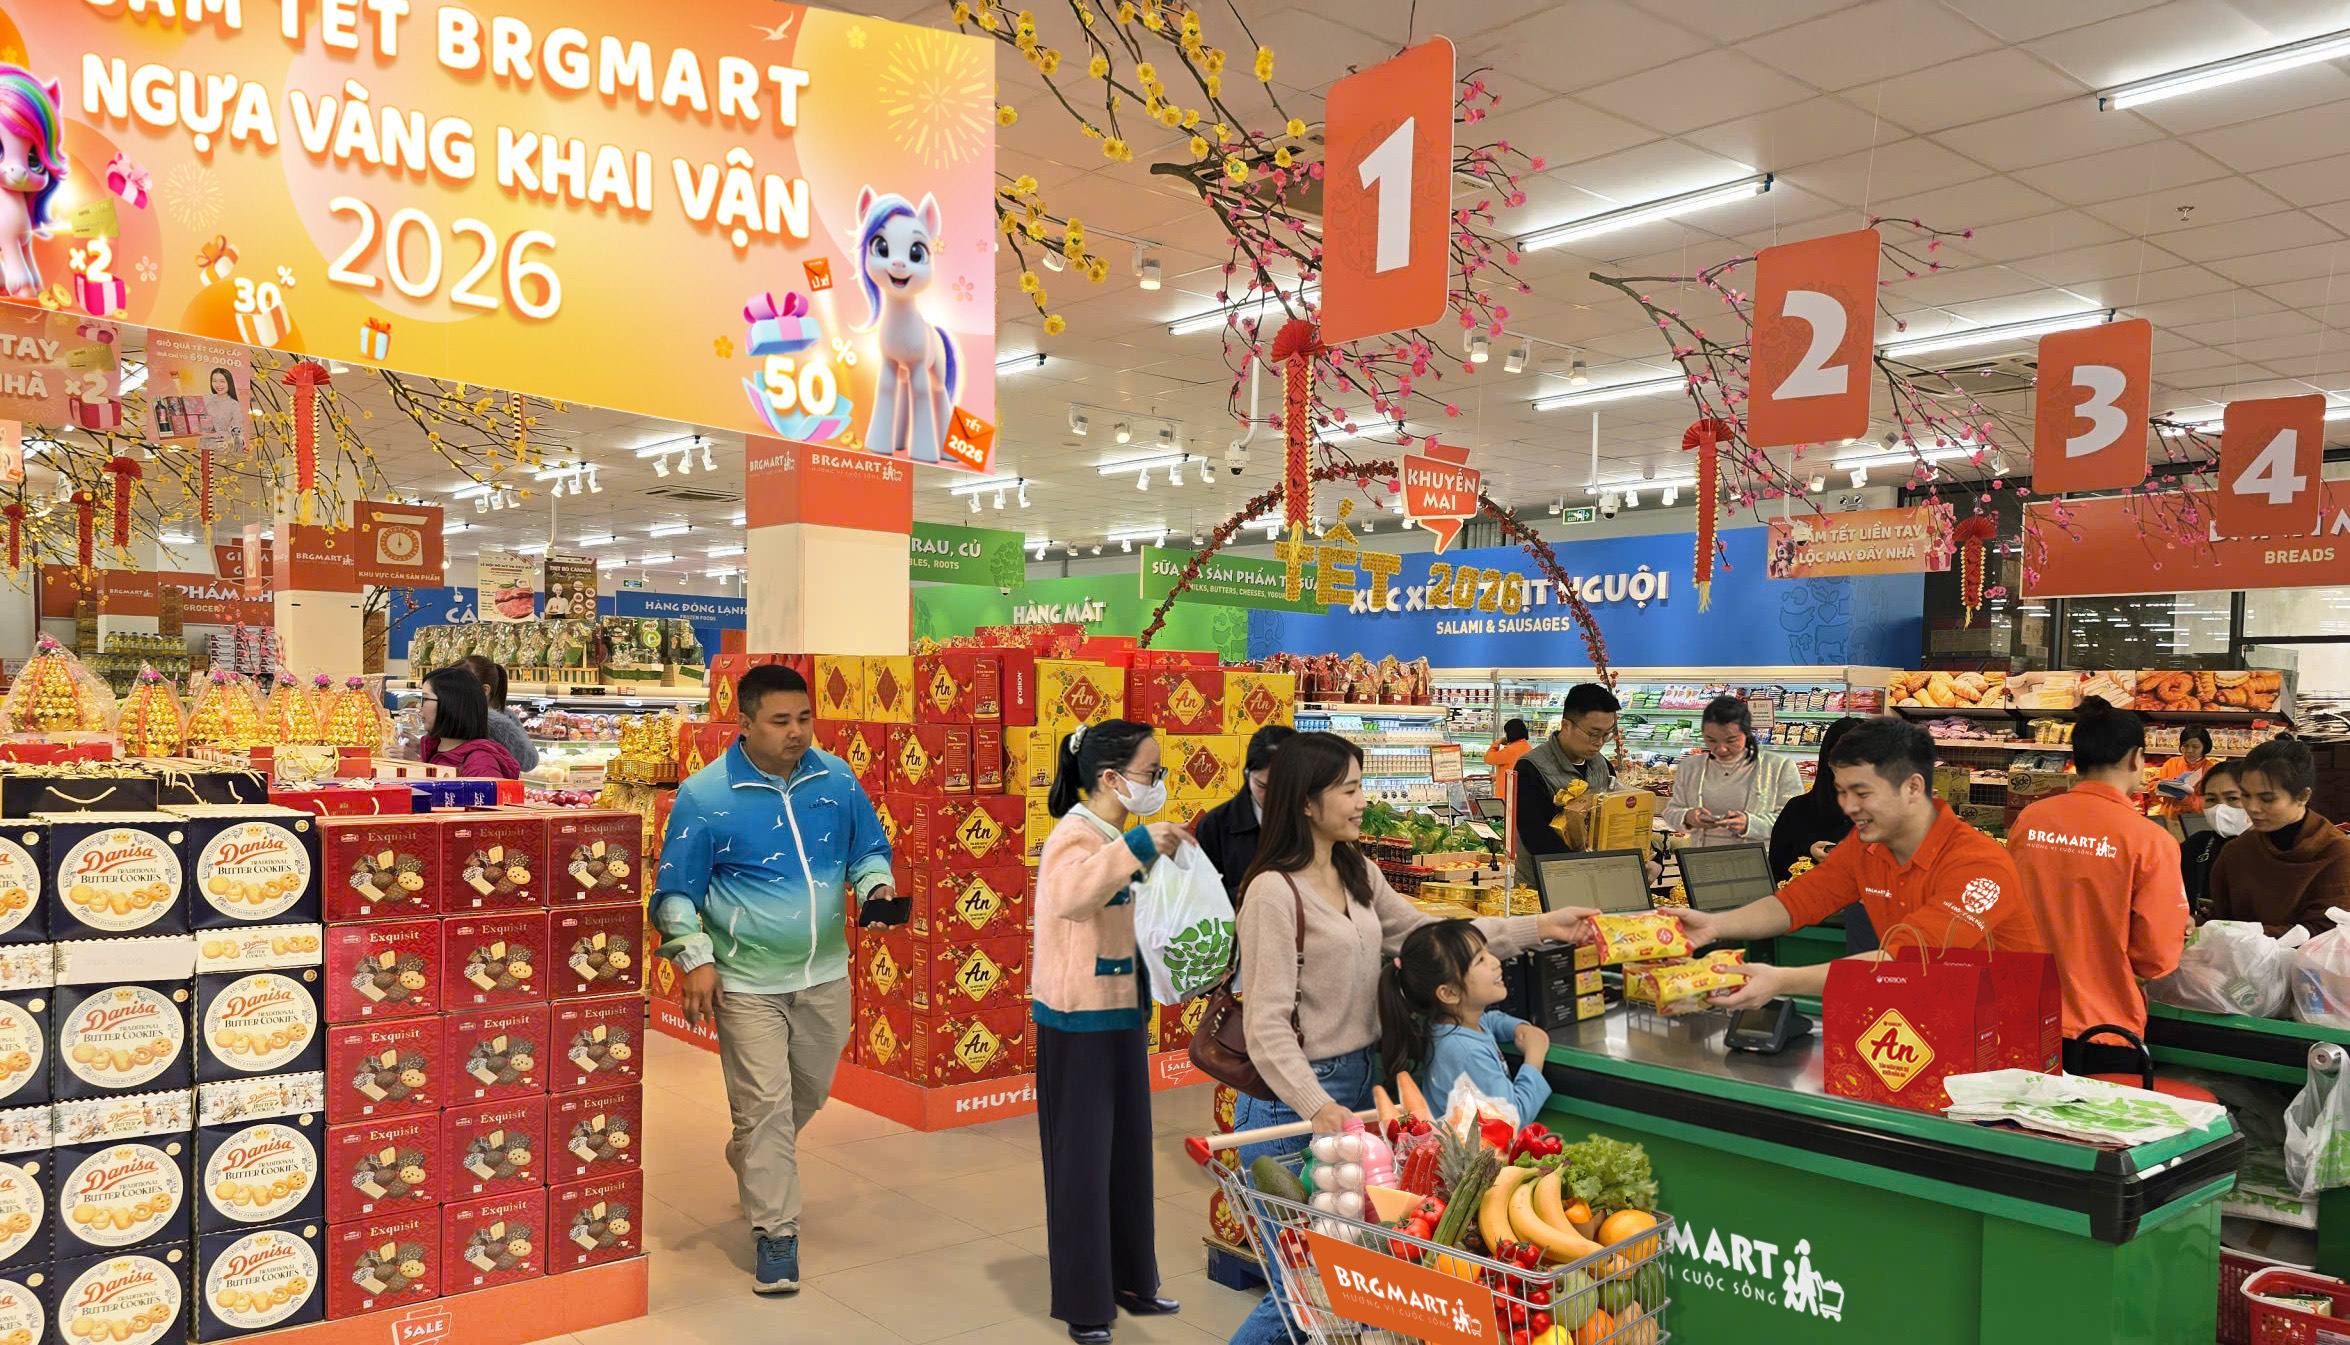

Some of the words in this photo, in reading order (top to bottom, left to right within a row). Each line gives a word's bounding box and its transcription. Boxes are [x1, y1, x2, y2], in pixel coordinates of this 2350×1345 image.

[437, 5, 809, 129] BRGMART
[82, 52, 278, 152] NGỰA
[289, 78, 476, 180] VÀNG
[497, 125, 653, 212] KHAI
[672, 146, 810, 248] VẬN
[1357, 115, 1415, 274] 1
[327, 196, 562, 319] 2026
[1771, 290, 1849, 401] 2
[0, 369, 48, 398] HÀ
[2066, 364, 2128, 459] 3
[964, 418, 983, 433] TẾT
[948, 435, 983, 464] 2026
[750, 455, 784, 472] BRGMART
[812, 453, 882, 473] BRGMART
[2232, 428, 2307, 506] 4
[1408, 467, 1476, 494] KHUYẾN
[1423, 492, 1457, 514] MẠI
[1806, 525, 1827, 544] ẮM
[1830, 523, 1857, 542] TẾT
[1859, 521, 1892, 542] LIỀN
[1895, 524, 1923, 539] TAY
[296, 552, 342, 562] BRGMART
[912, 537, 954, 558] RAU,
[959, 539, 982, 558] CỦ
[1274, 497, 1402, 606] TẾT
[1428, 562, 1524, 615] 2026
[1799, 549, 1824, 568] LỘC
[1825, 549, 1855, 564] MAY
[1855, 547, 1884, 562] ĐẦY
[1886, 545, 1916, 560] NHÀ
[2265, 548, 2335, 564] BREADS
[934, 560, 960, 570] ROOTS
[375, 571, 390, 580] VỰC
[391, 571, 405, 580] CÂN
[406, 572, 421, 581] SẢN
[421, 573, 440, 582] PHẨM
[1207, 564, 1234, 583] SẢN
[1236, 567, 1277, 587] PHẨM
[1210, 585, 1239, 596] BUTTERS,
[1240, 588, 1267, 598] CHEESES,
[184, 604, 226, 613] GROCERY
[645, 600, 679, 612] HÀNG
[682, 602, 715, 613] ĐÔNG
[718, 605, 748, 616] LẠNH
[1013, 599, 1061, 625] HÀNG
[1436, 620, 1483, 635] SALAMI
[1486, 621, 1496, 634] &
[1498, 617, 1570, 634] SAUSAGES
[367, 831, 417, 844] Exquisit
[479, 827, 525, 840] Exquisit
[583, 823, 625, 834] Exquisit
[2028, 829, 2097, 848] BRGMART
[77, 843, 157, 874] Danisa
[215, 836, 287, 866] Danisa
[81, 875, 118, 884] BUTTER
[120, 874, 161, 883] COOKIES
[218, 867, 252, 875] BUTTER
[254, 865, 292, 874] COOKIES
[481, 922, 528, 935] Exquisit
[584, 914, 626, 927] Exquisit
[369, 931, 420, 945] Exquisit
[222, 989, 295, 1018] Danisa
[585, 1006, 627, 1020] Exquisit
[80, 1002, 160, 1034] Danisa
[225, 1017, 260, 1028] BUTTER
[262, 1015, 299, 1026] COOKIES
[483, 1015, 530, 1030] Exquisit
[84, 1031, 121, 1041] BUTTER
[122, 1029, 163, 1040] COOKIES
[370, 1028, 420, 1044] Exquisit
[1870, 1028, 1920, 1064] An
[1167, 1061, 1192, 1072] SALE
[583, 1095, 625, 1109] Exquisit
[956, 1083, 1038, 1112] KHUYẾ
[480, 1109, 526, 1125] Exquisit
[369, 1125, 419, 1142] Exquisit
[222, 1138, 295, 1171] Danisa
[80, 1159, 159, 1193] Danisa
[226, 1170, 261, 1180] BUTTER
[261, 1164, 298, 1176] COOKIES
[83, 1193, 120, 1203] BUTTER
[122, 1185, 163, 1199] COOKIES
[584, 1182, 626, 1198] Exquisit
[481, 1201, 527, 1218] Exquisit
[369, 1220, 419, 1238] Exquisit
[223, 1244, 296, 1279] Danisa
[226, 1277, 261, 1288] BUTTER
[262, 1269, 299, 1283] COOKIES
[1682, 1268, 1725, 1291] CUỘC
[1733, 1280, 1777, 1305] SỐNG
[78, 1270, 157, 1307] Danisa
[1333, 1264, 1449, 1316] BRGMART
[82, 1306, 119, 1316] BUTTER
[120, 1296, 161, 1311] COOKIES
[1342, 1291, 1380, 1309] HƯƠNG
[1385, 1305, 1395, 1316] VỊ
[1399, 1308, 1424, 1323] CUỘC
[1428, 1314, 1452, 1330] SỐNG
[403, 1319, 444, 1340] SALE
